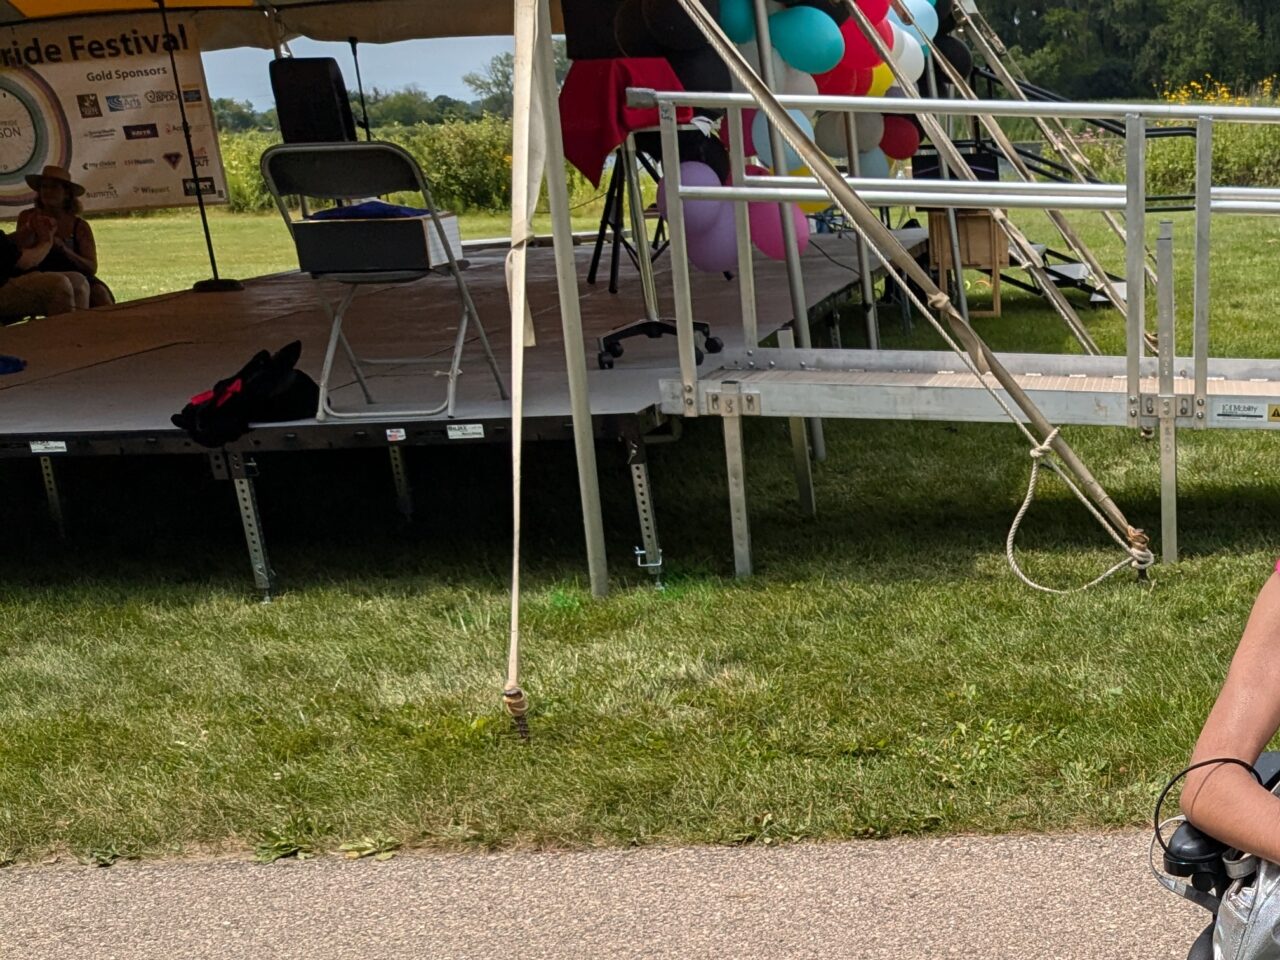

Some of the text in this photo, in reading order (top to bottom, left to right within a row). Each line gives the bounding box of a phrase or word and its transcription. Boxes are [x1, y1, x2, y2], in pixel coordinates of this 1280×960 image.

[68, 24, 189, 60] Festival
[86, 66, 168, 82] Gold Sponsors
